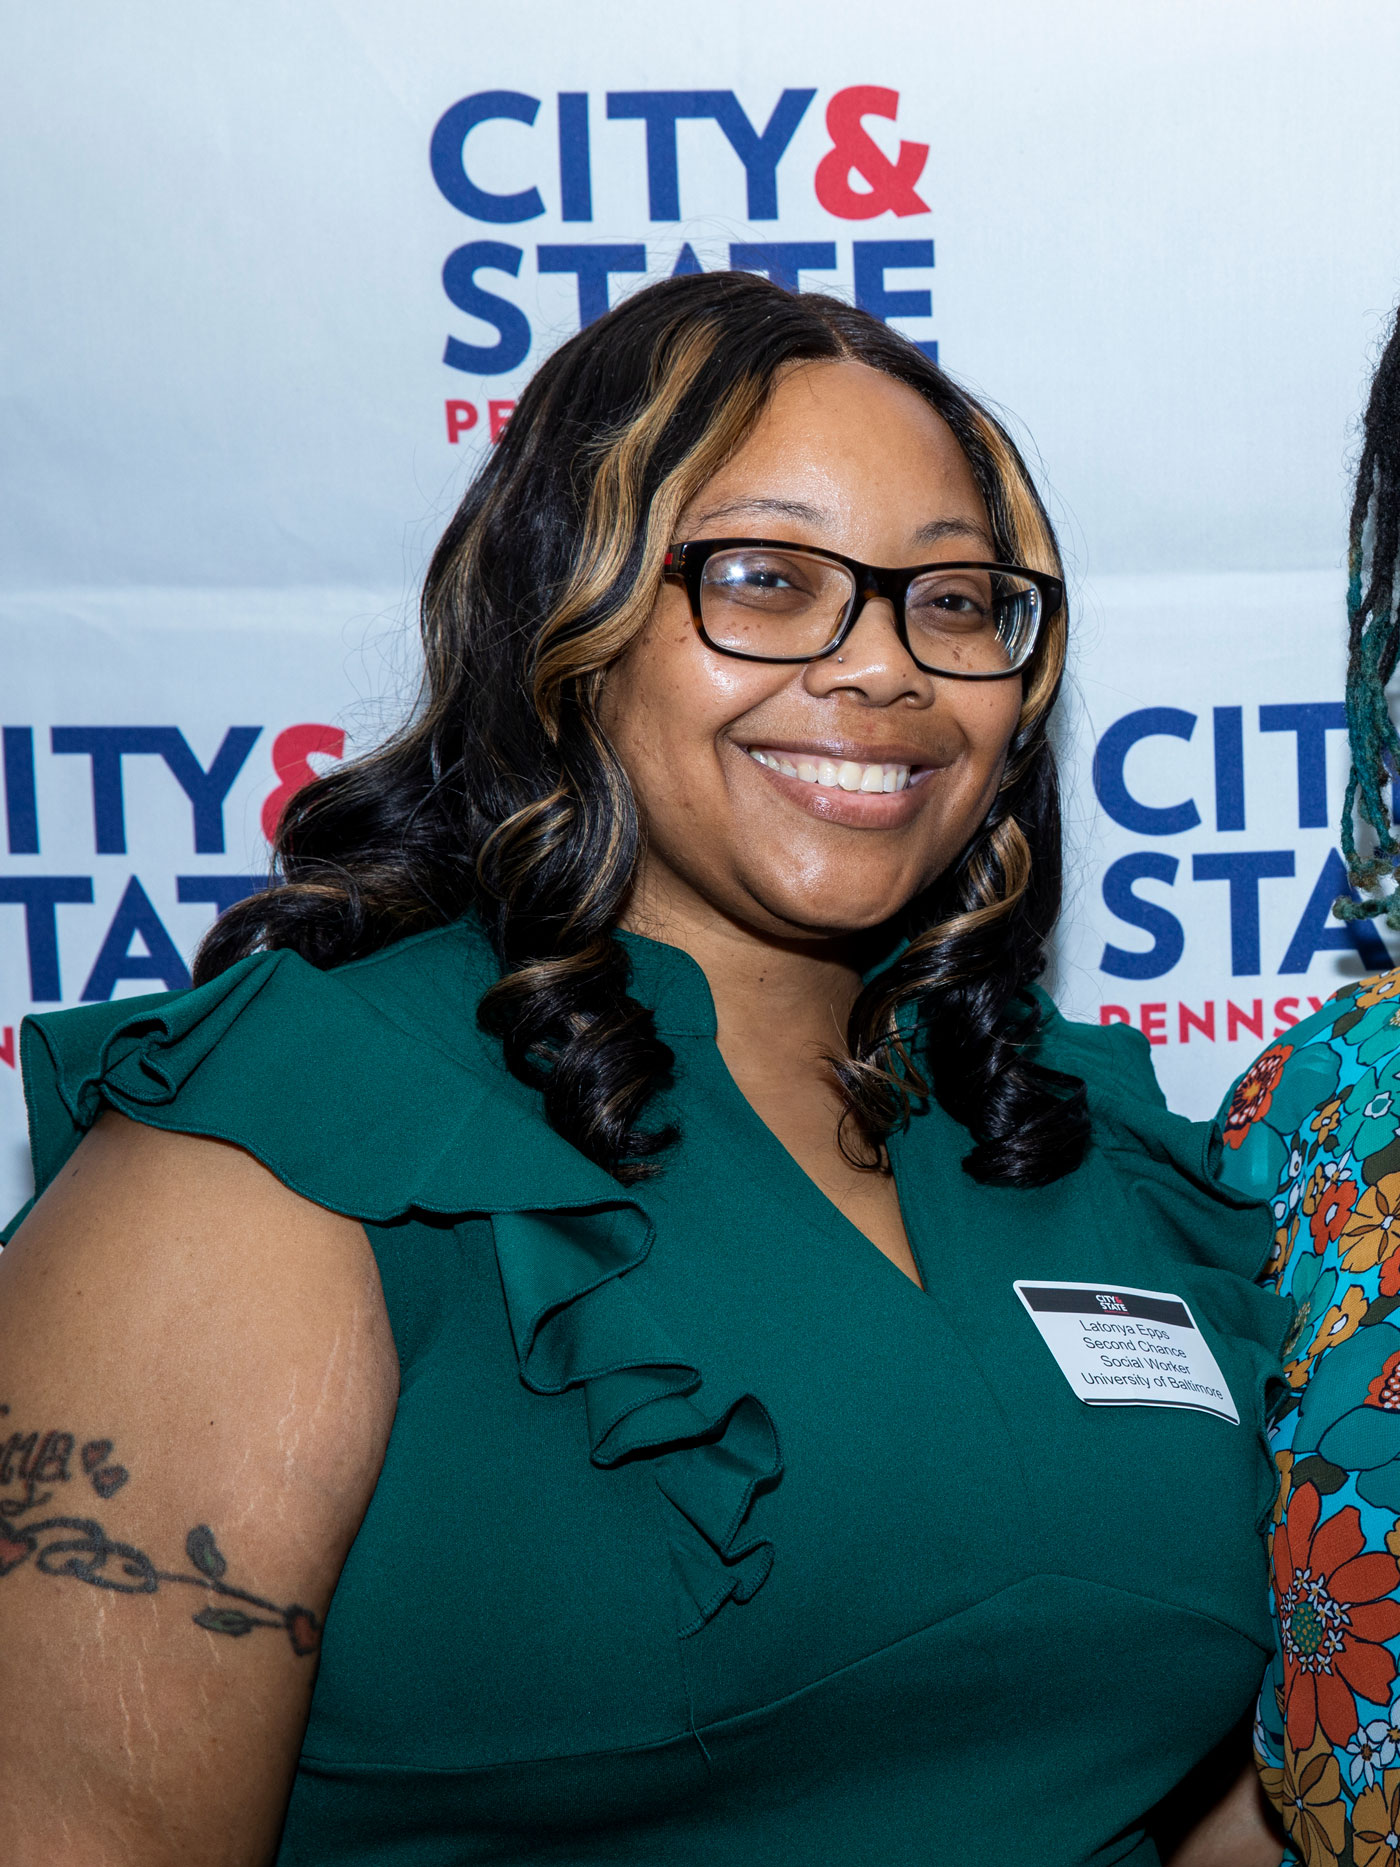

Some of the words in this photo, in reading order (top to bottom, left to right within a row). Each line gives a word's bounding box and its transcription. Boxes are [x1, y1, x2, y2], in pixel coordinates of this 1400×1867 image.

[429, 84, 932, 224] CITY&
[1, 723, 346, 856] ITY&
[1100, 1302, 1128, 1312] STATE
[1079, 1319, 1135, 1336] Latonya
[1135, 1323, 1170, 1341] Epps
[1083, 1336, 1136, 1351] Second
[1137, 1340, 1187, 1358] Chance
[1100, 1354, 1144, 1370] Social
[1143, 1357, 1191, 1375] Worker
[1081, 1372, 1151, 1389] University
[1153, 1375, 1168, 1388] of
[1167, 1376, 1224, 1400] Baltimore
